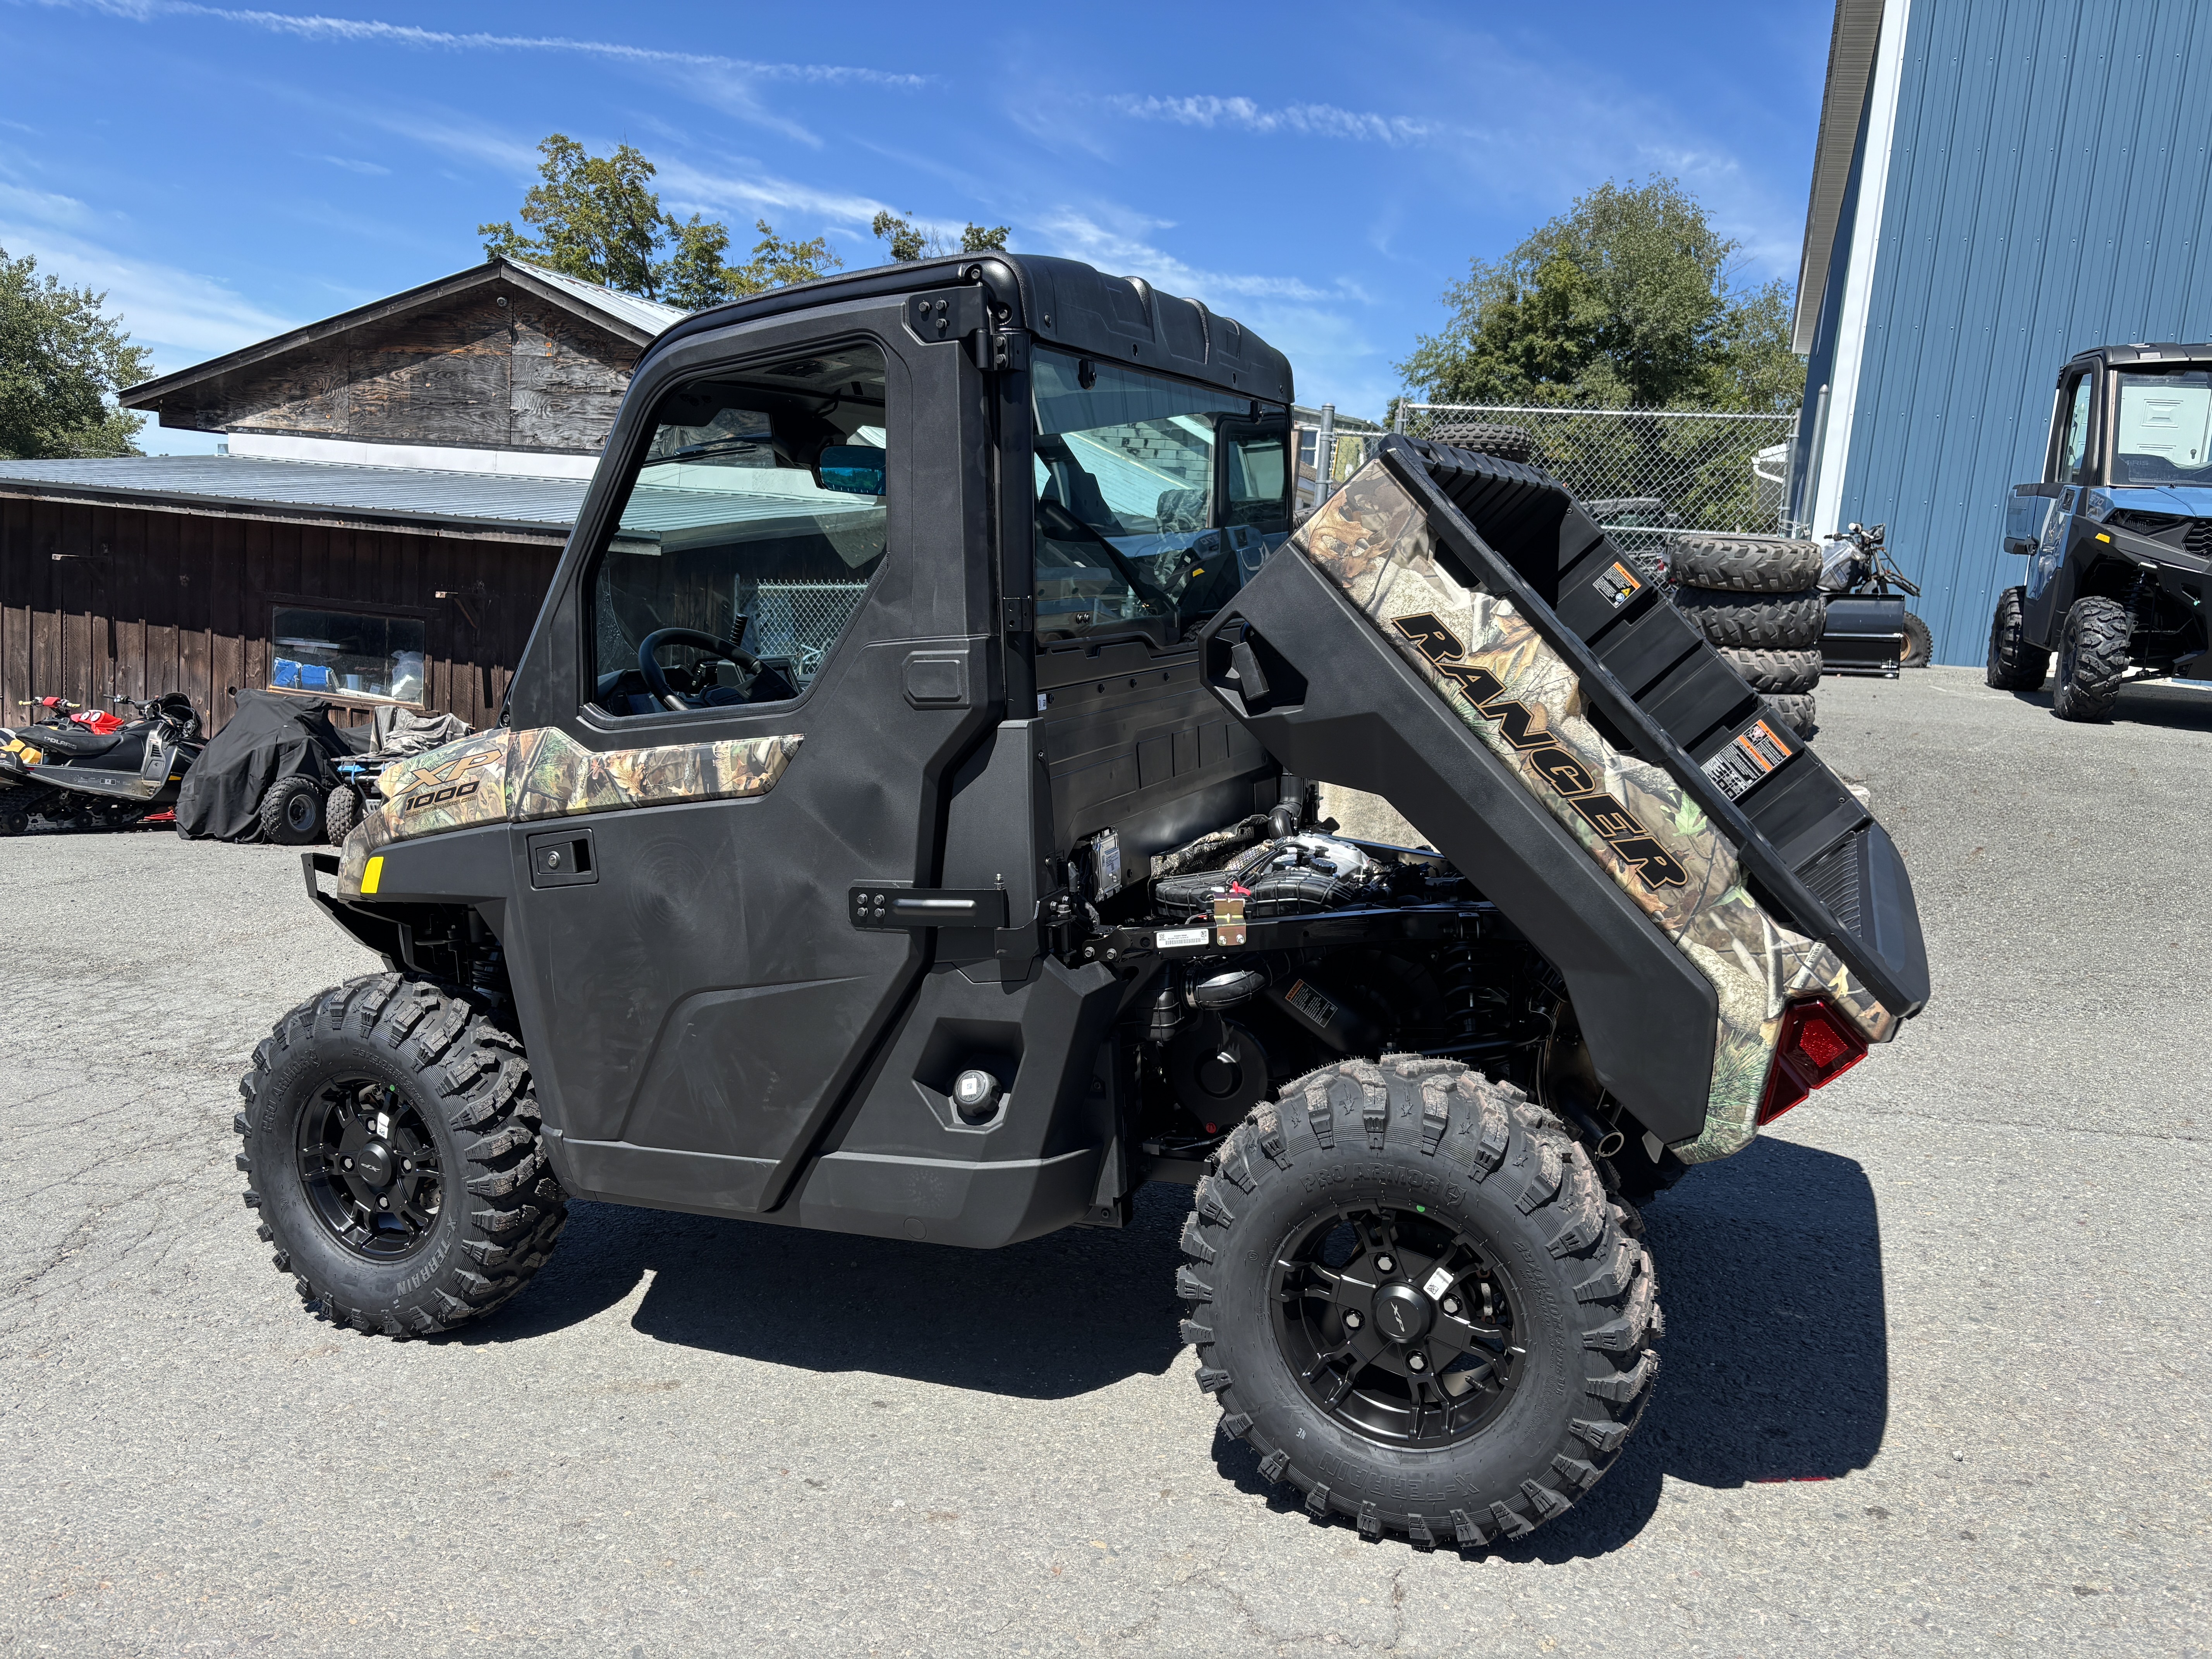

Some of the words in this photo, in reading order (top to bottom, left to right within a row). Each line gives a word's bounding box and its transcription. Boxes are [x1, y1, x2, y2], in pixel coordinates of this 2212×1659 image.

[2090, 494, 2105, 506] 570
[44, 736, 77, 750] POLARIS
[1391, 611, 1688, 890] RANGER
[391, 749, 503, 798] XP
[405, 780, 480, 811] 1000
[261, 1099, 278, 1133] PRO
[272, 1056, 310, 1101] ARMOR
[1299, 1164, 1347, 1193] PRO
[1353, 1162, 1441, 1195] ARMOR
[396, 1212, 458, 1298] X-TERRAIN
[1390, 1301, 1405, 1332] XP
[1317, 1450, 1480, 1501] X-TERRAIN
